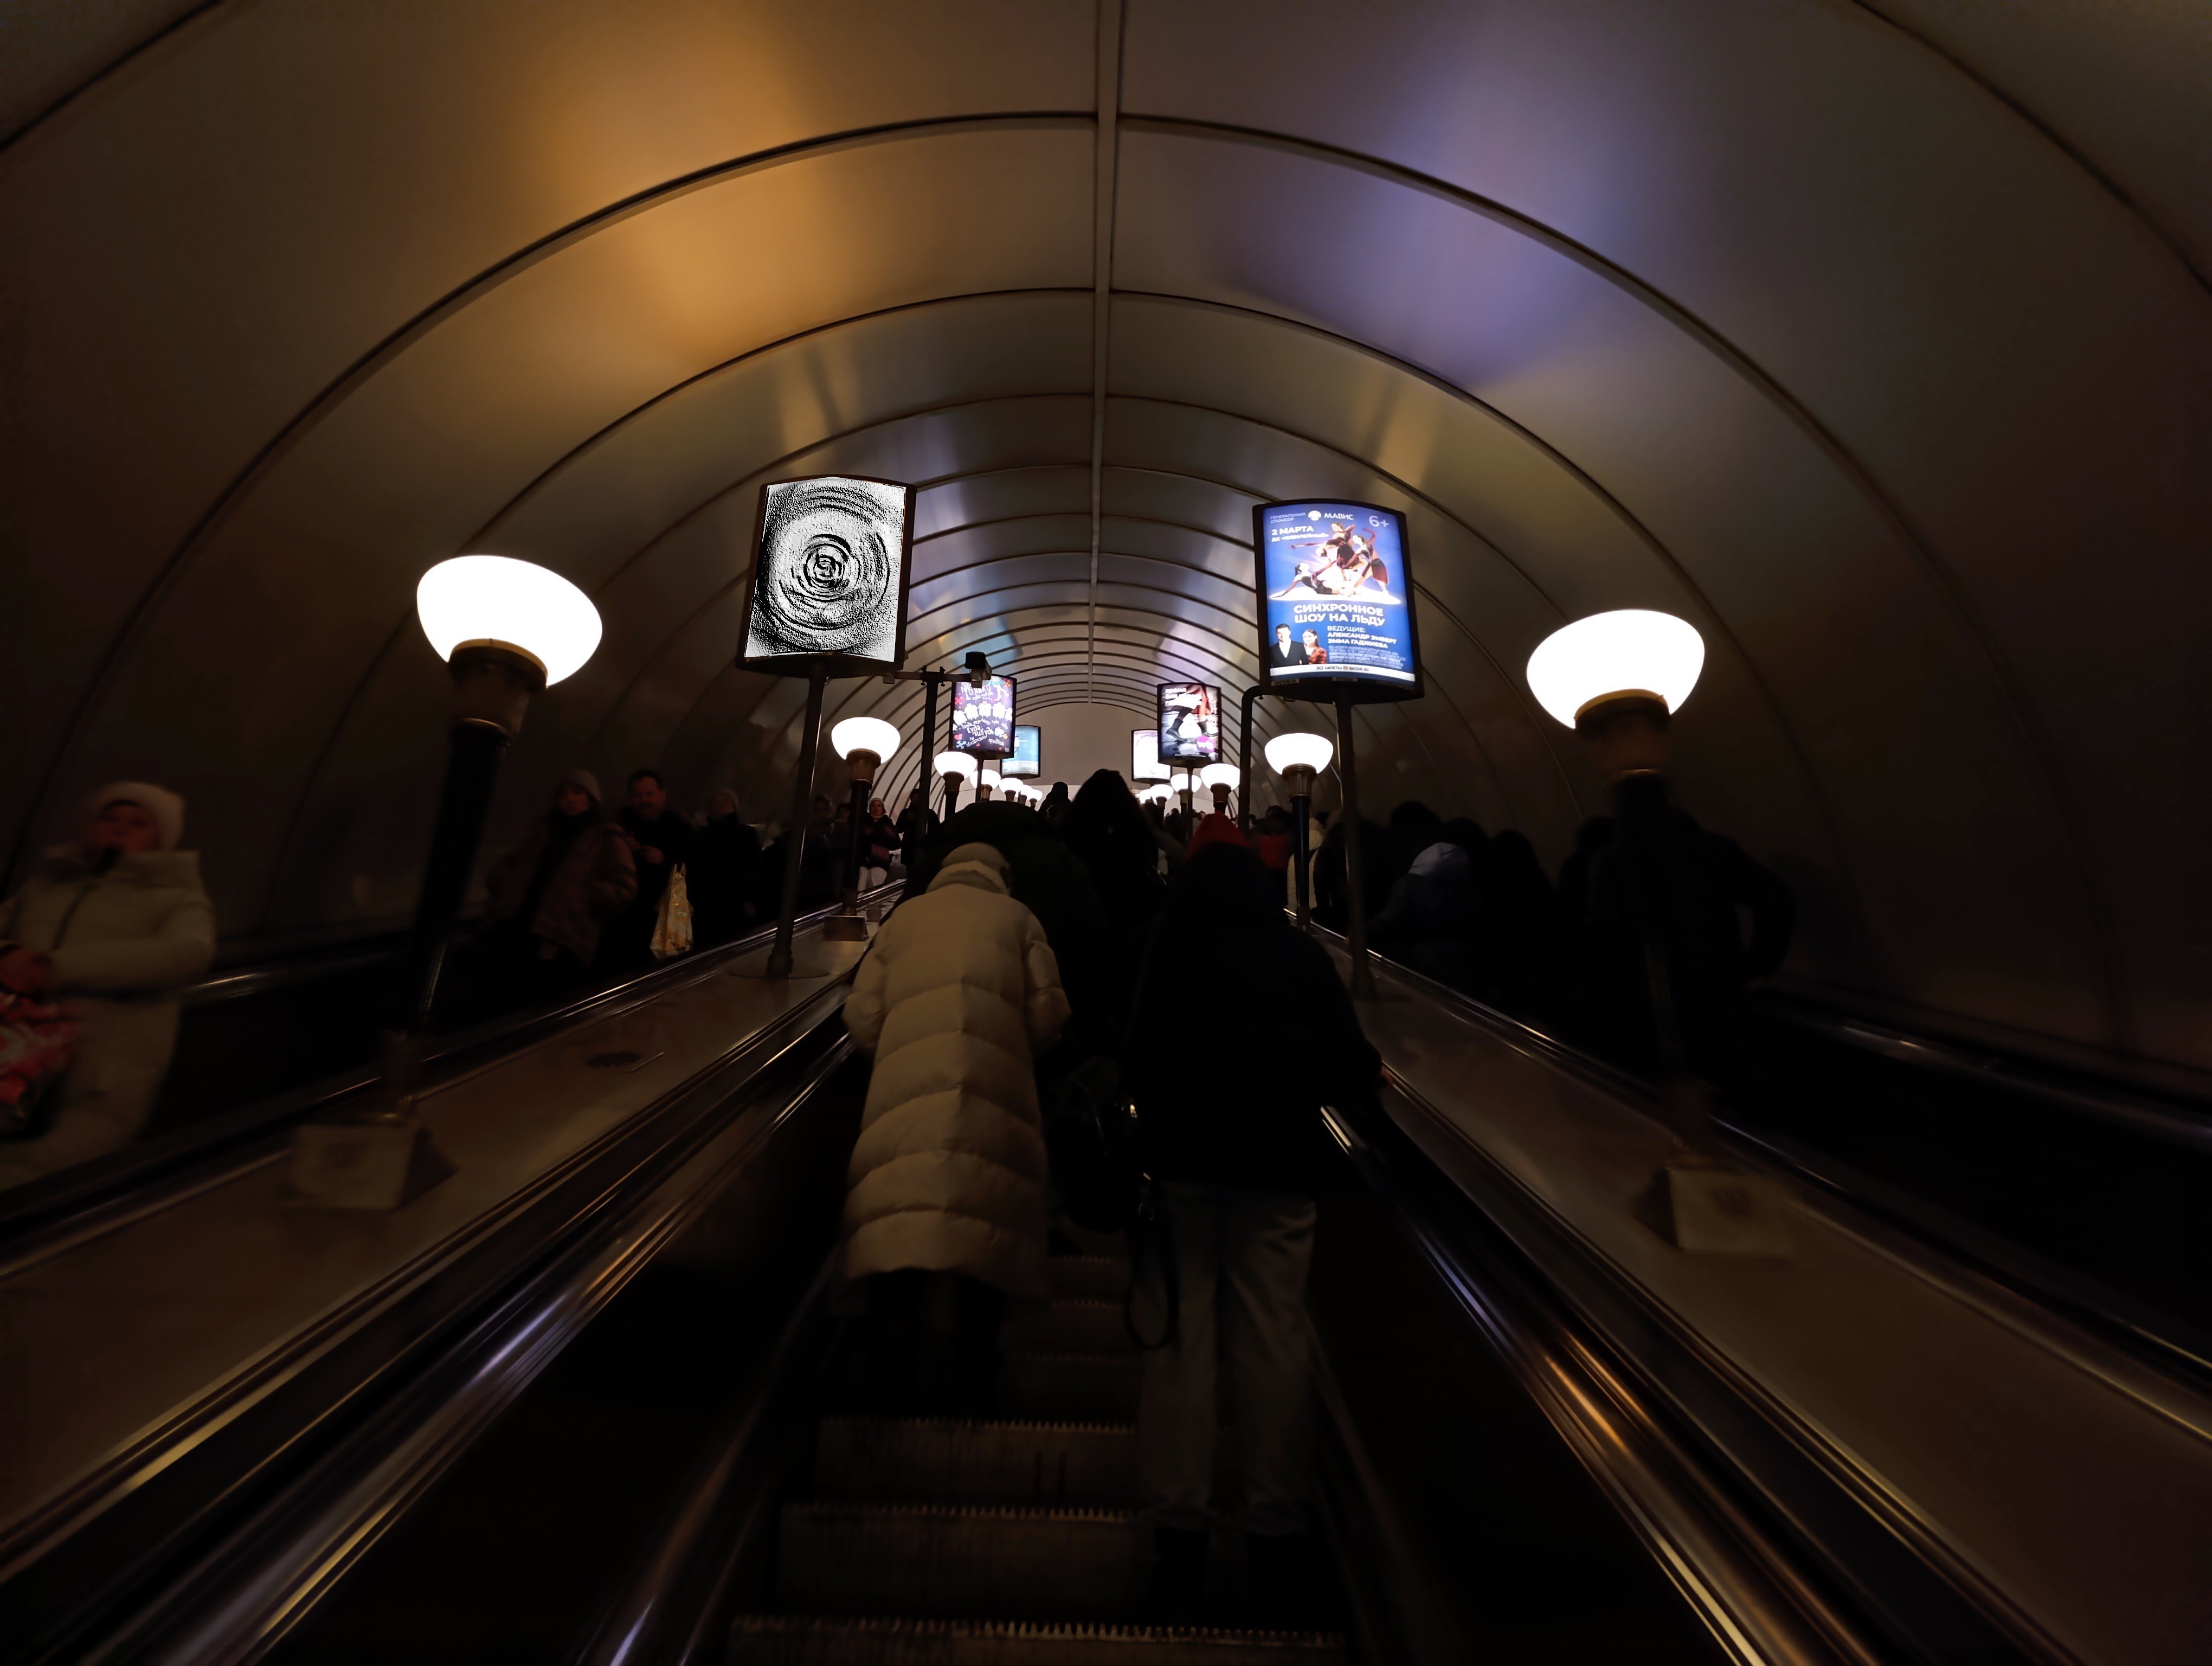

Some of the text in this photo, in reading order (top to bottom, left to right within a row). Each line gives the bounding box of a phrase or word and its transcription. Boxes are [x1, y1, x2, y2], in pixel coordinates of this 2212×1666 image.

[1324, 512, 1354, 521] МАВИС
[1369, 515, 1389, 528] 6+
[1279, 526, 1314, 534] МАРТА
[1294, 604, 1384, 617] СИНХРОННОЕ
[1295, 613, 1385, 626] ШОУ НА ЛЬДУ
[1327, 632, 1370, 640] АЛЕКСАНДР
